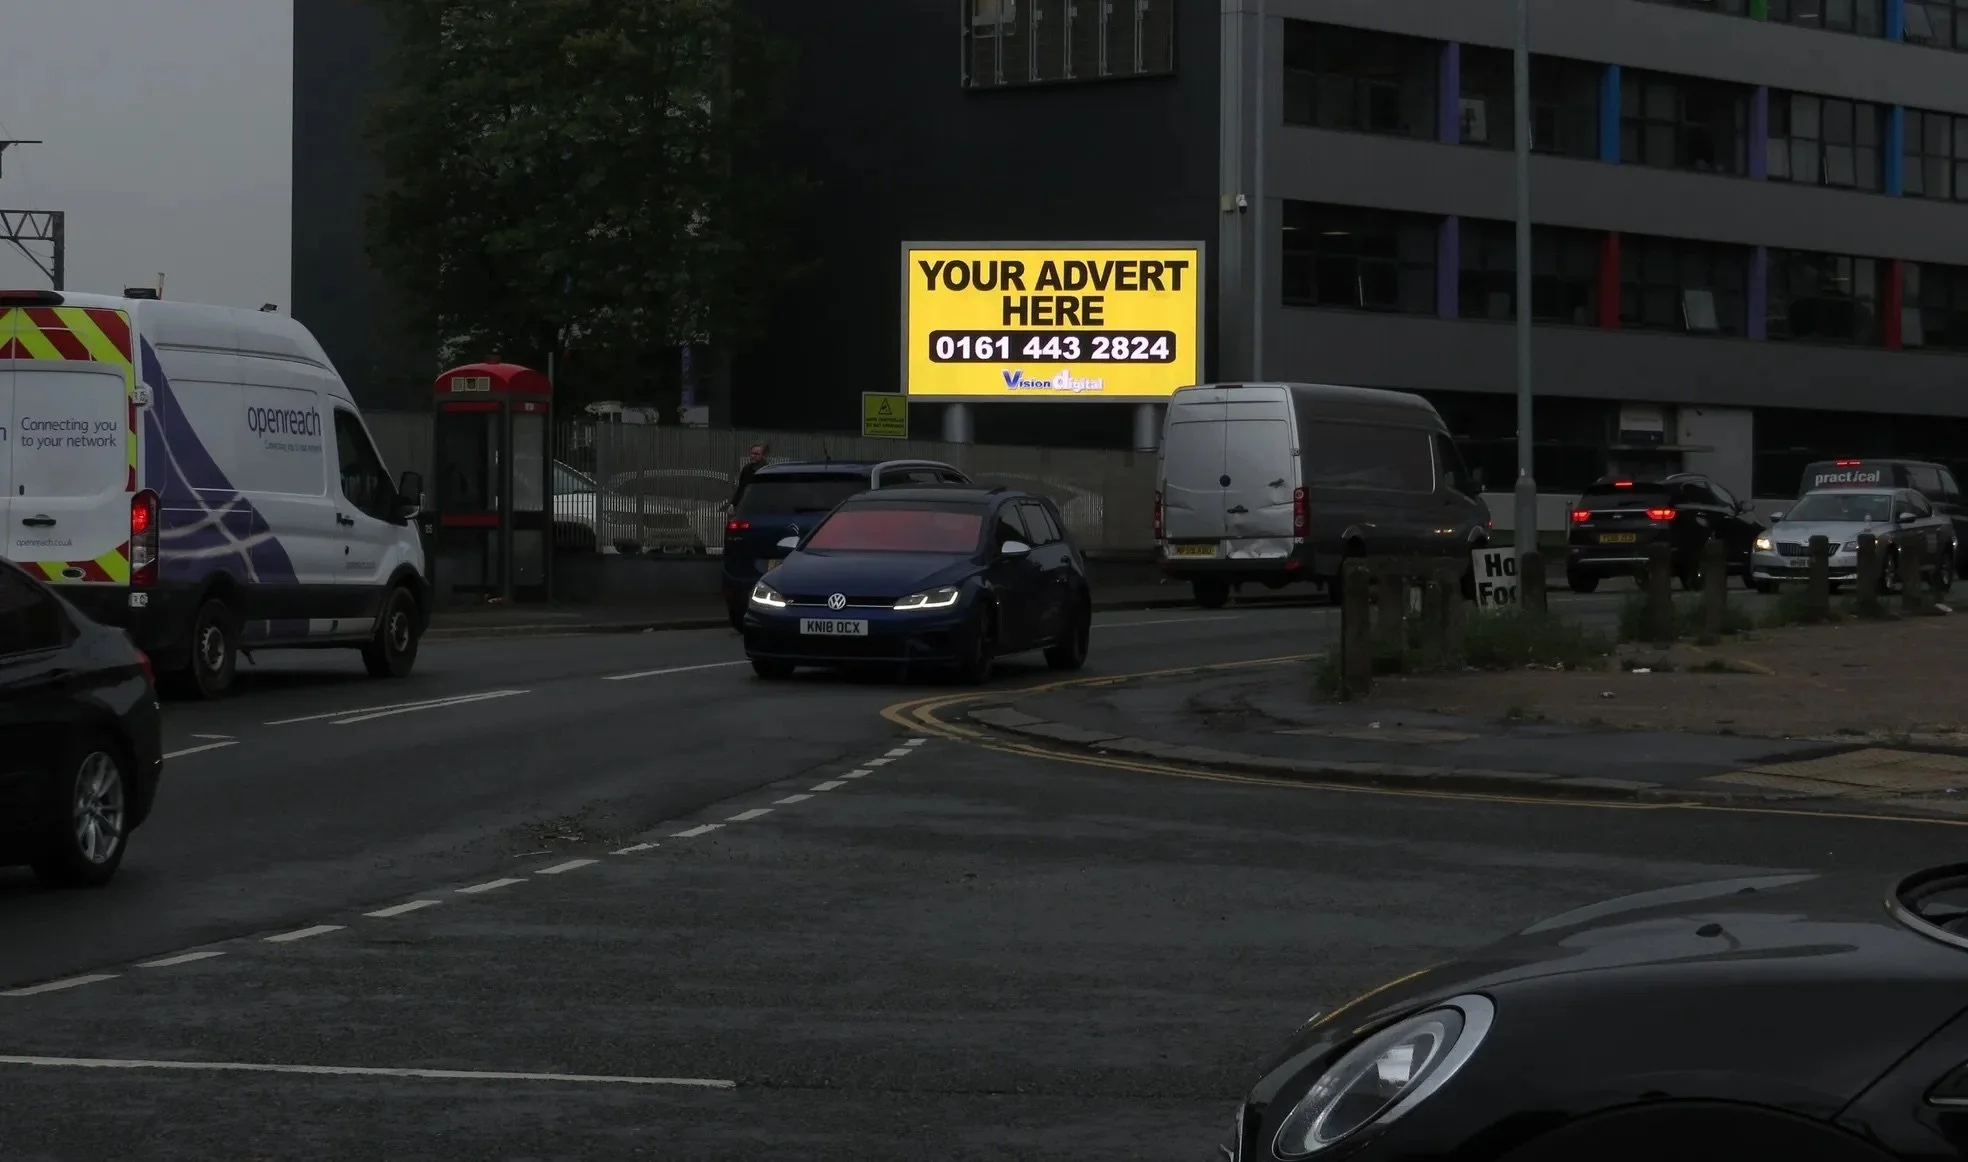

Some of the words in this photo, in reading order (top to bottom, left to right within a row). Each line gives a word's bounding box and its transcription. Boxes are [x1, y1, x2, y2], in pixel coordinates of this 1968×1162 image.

[919, 260, 1026, 291] YOUR
[1034, 260, 1189, 291] ADVERT
[1002, 295, 1105, 326] HERE
[936, 336, 1010, 360] 0161
[1023, 336, 1081, 360] 443
[1091, 336, 1170, 360] 2824
[21, 416, 89, 434] Connecting
[94, 420, 117, 434] you
[247, 406, 322, 438] openreach
[21, 435, 34, 447] to
[37, 437, 62, 450] your
[66, 434, 117, 447] network
[1815, 469, 1880, 487] practical
[1484, 553, 1517, 578] Ho
[806, 620, 833, 633] KN18
[836, 621, 861, 634] OCX
